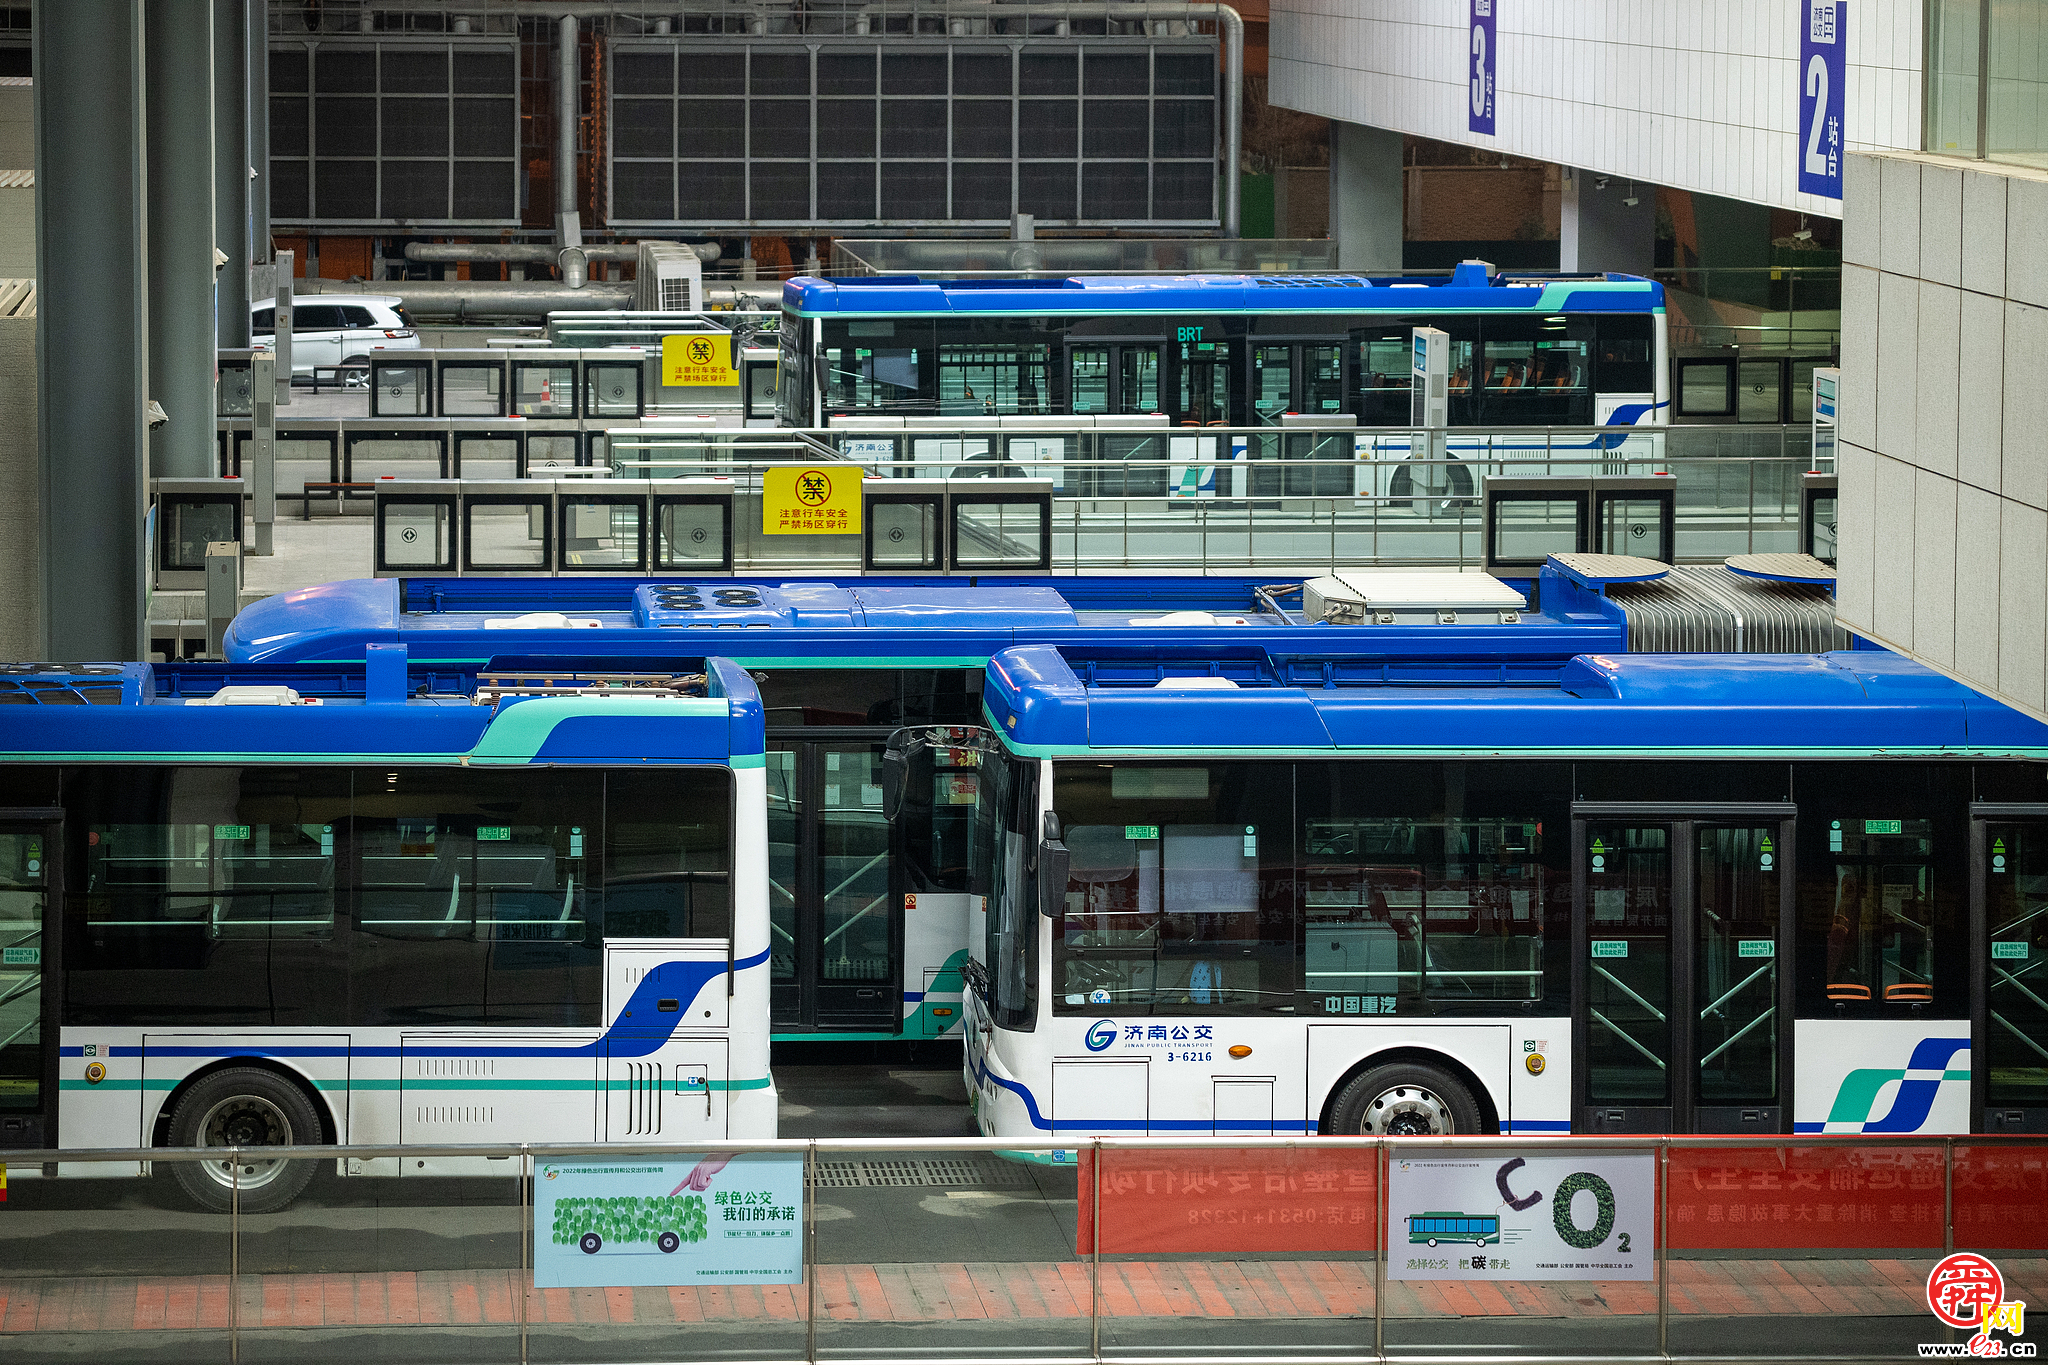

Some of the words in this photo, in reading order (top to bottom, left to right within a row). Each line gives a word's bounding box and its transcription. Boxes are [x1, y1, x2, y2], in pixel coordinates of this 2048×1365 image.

[1472, 24, 1486, 117] 3
[1485, 71, 1492, 119] 站台
[1805, 54, 1829, 176] 2
[1828, 116, 1839, 178] 站台
[1177, 326, 1204, 342] BRT
[692, 342, 710, 360] 禁
[674, 366, 727, 374] 注意行车安全
[674, 374, 727, 382] 严禁场区穿行
[802, 477, 825, 500] 禁
[779, 508, 848, 518] 注意行车安全
[779, 519, 848, 529] 严禁场区穿行
[1325, 995, 1397, 1014] 中国重汽
[1124, 1025, 1213, 1041] 济南公交
[1167, 1052, 1212, 1062] 3-6216
[714, 1190, 773, 1206] 绿色公交
[722, 1205, 796, 1221] 我们的承诺
[1406, 1258, 1449, 1270] 选择公交
